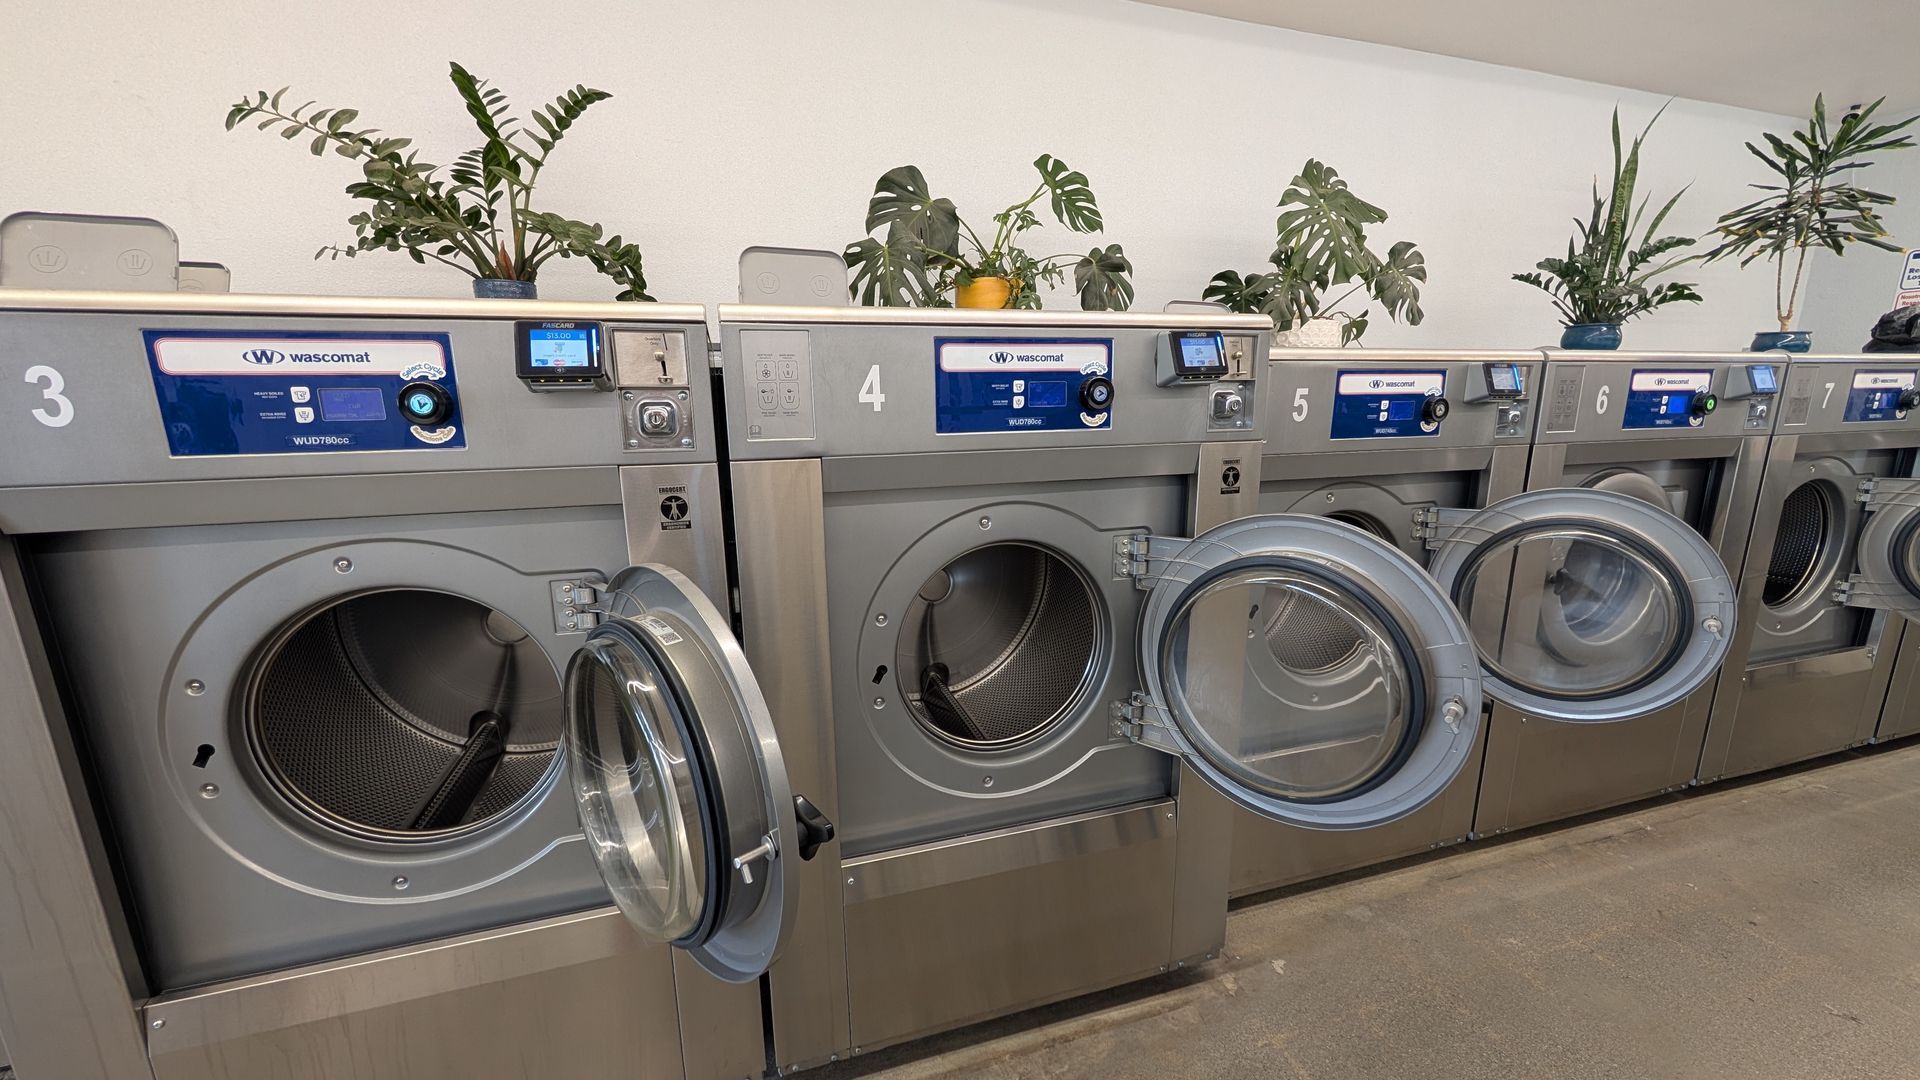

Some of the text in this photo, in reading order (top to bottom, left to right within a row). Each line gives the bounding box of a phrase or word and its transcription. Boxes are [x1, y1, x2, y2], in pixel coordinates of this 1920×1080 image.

[290, 352, 371, 362] wascomat
[402, 363, 444, 378] Select Cycle
[1017, 353, 1064, 362] wascomat
[24, 365, 74, 428] 3
[858, 364, 886, 412] 4
[1596, 385, 1610, 415] 6
[1823, 382, 1836, 409] 7
[1292, 388, 1308, 422] 5
[293, 436, 350, 445] WUD780cc
